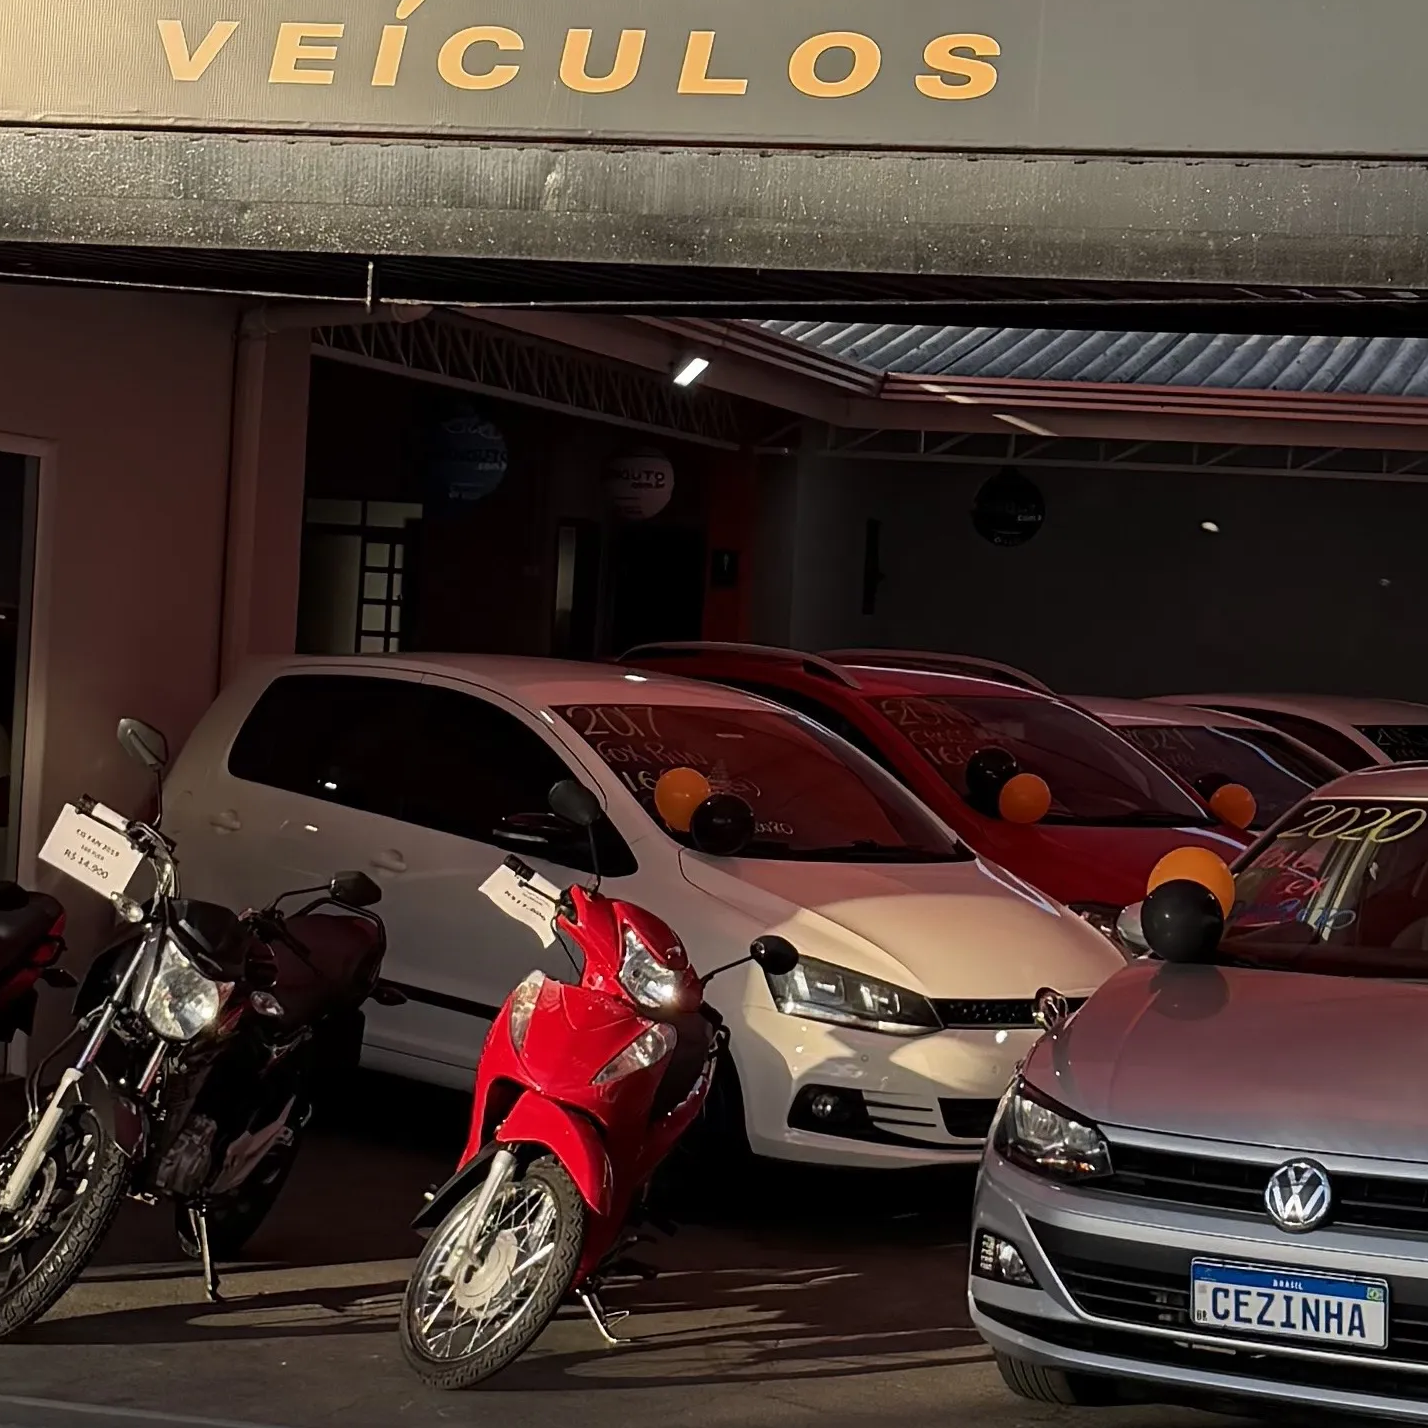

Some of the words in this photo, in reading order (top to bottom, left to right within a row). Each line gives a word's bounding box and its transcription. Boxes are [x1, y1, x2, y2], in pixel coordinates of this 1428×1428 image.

[565, 706, 662, 738] 2017
[1277, 804, 1427, 844] 2020
[64, 849, 78, 861] R$
[1211, 1286, 1367, 1339] CEZINHA
